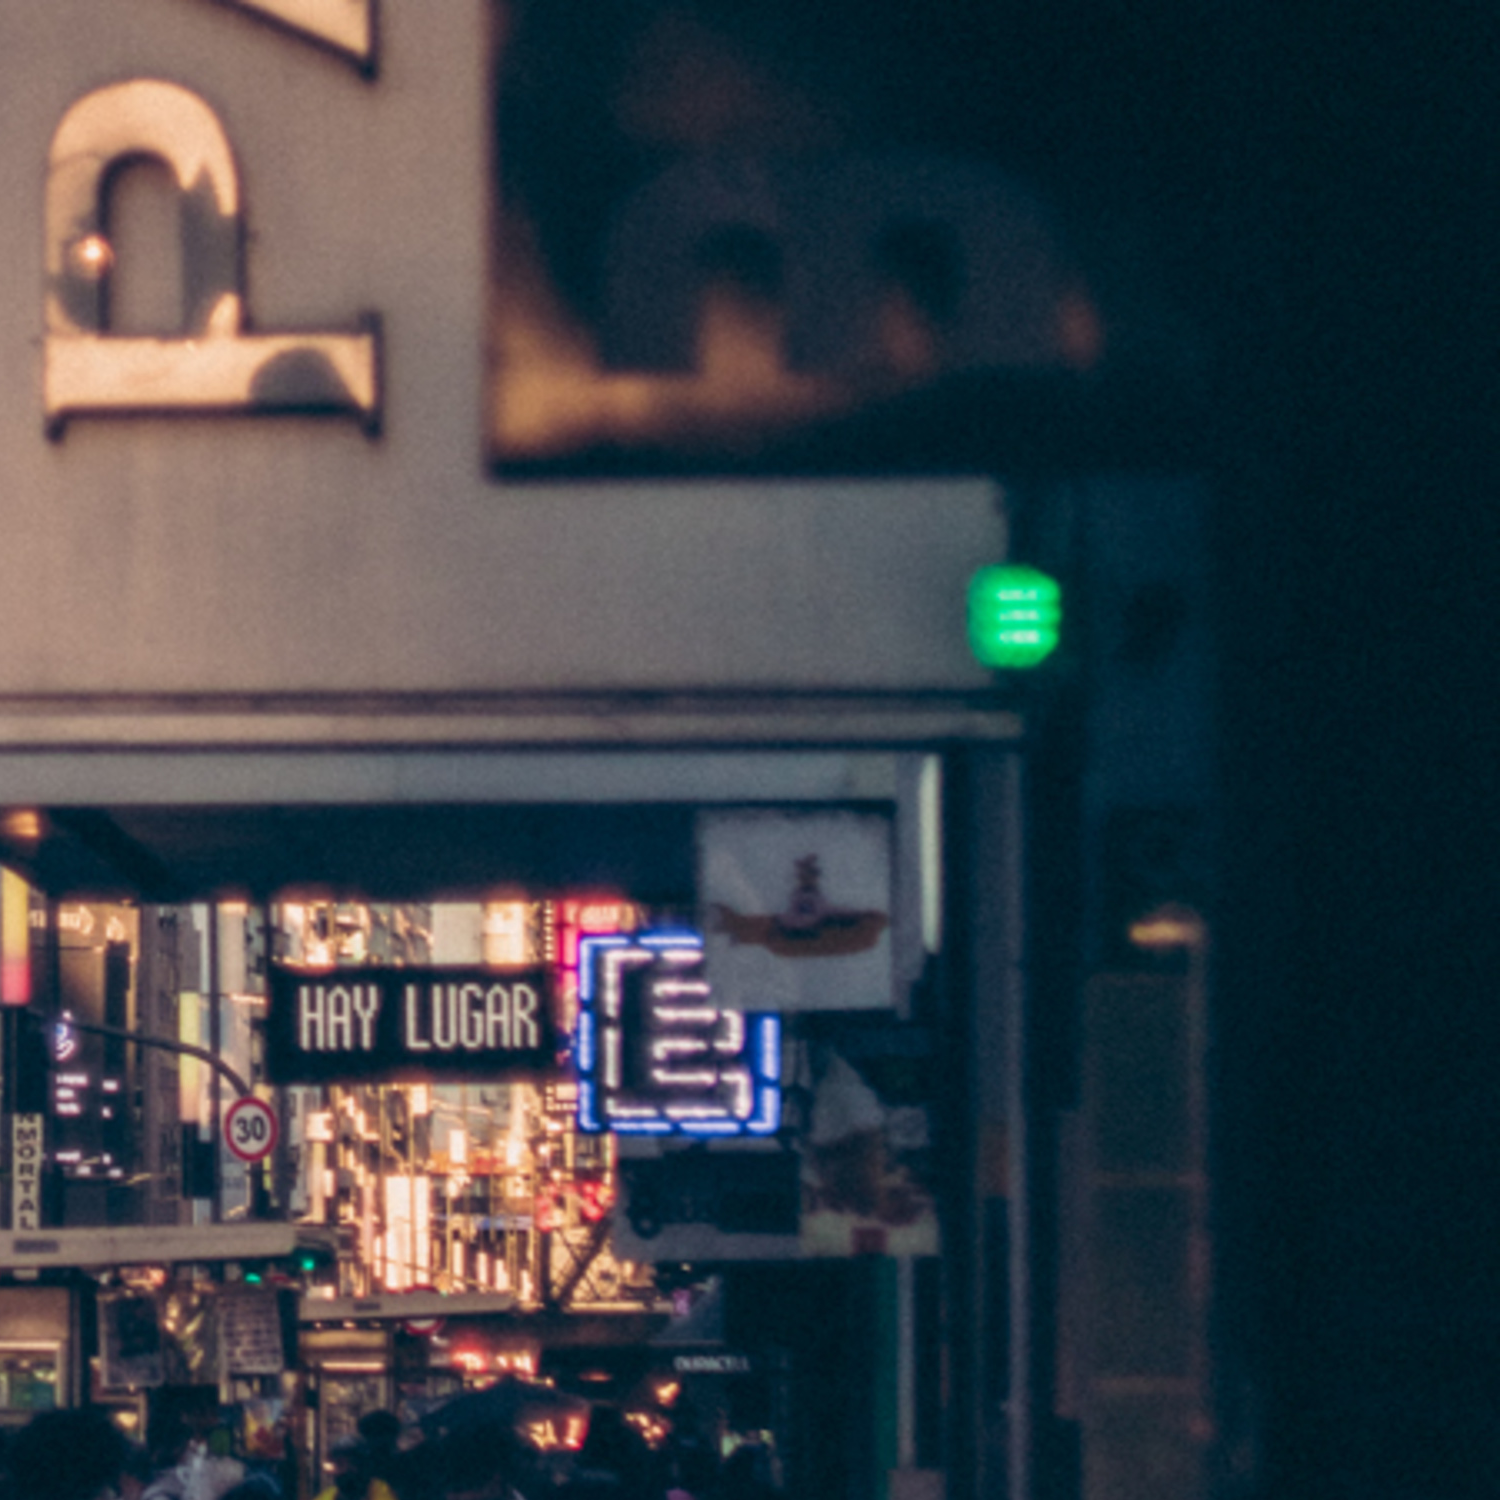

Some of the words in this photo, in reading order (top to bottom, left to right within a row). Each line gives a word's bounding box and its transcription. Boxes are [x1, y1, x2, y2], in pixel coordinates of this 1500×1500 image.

[299, 985, 380, 1050] HAY
[404, 984, 539, 1050] LUGAR
[235, 1116, 266, 1143] 30
